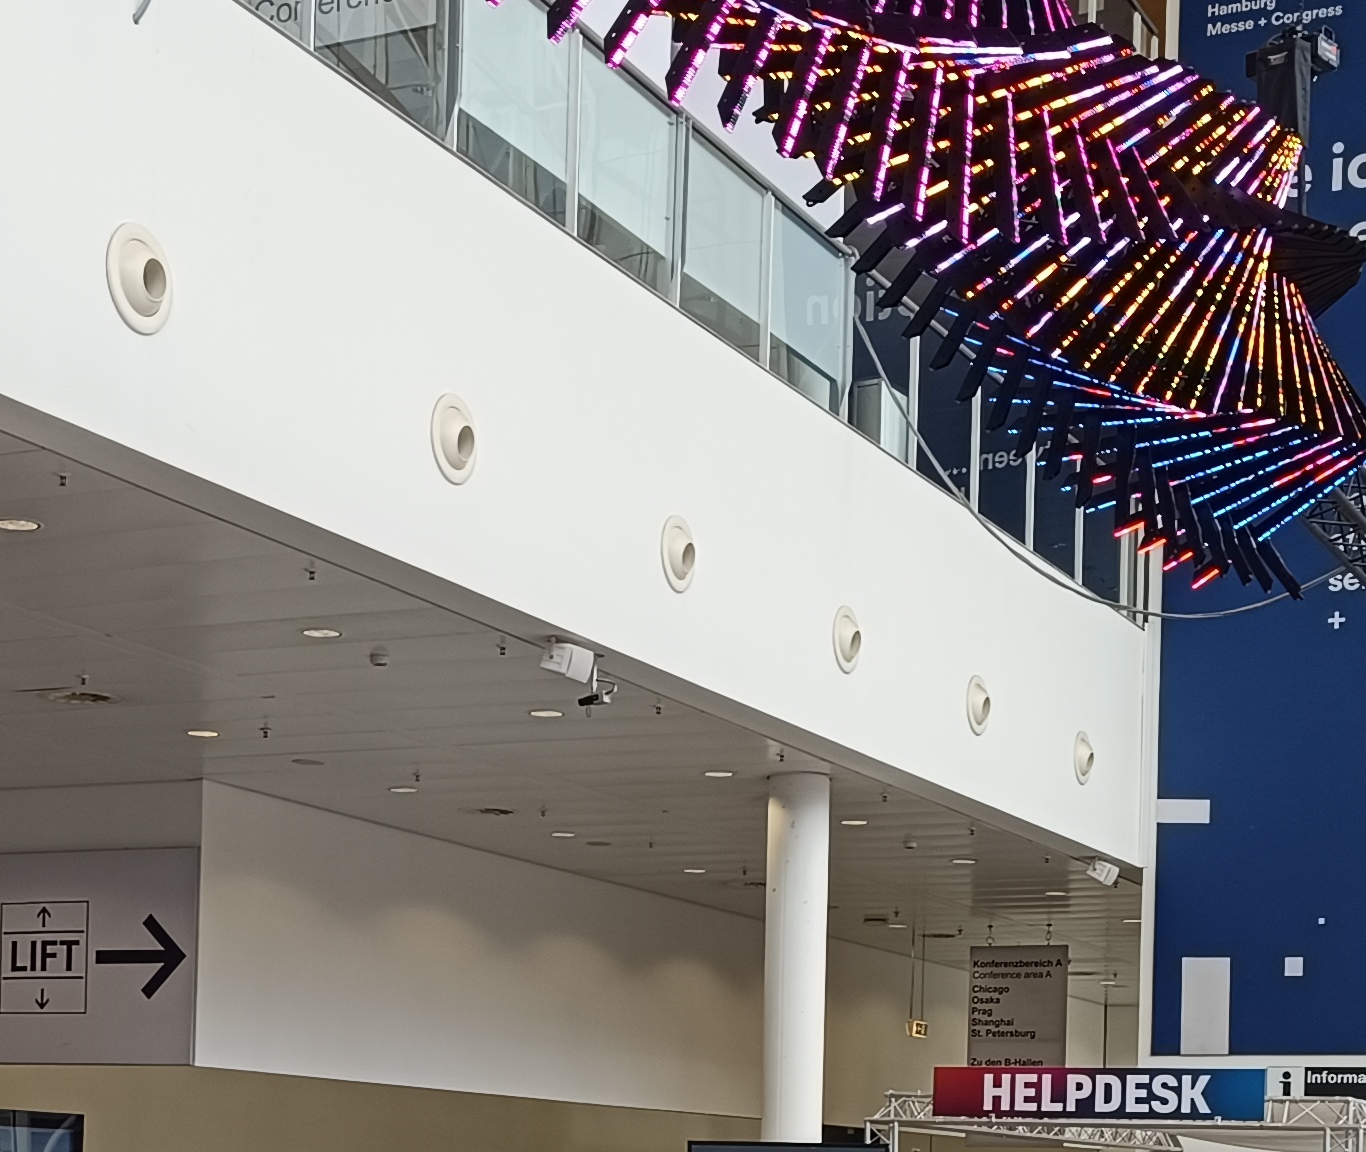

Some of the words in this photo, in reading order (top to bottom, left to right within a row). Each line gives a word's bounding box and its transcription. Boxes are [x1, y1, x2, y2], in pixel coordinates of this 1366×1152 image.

[1207, 0, 1276, 17] Hamburg
[1206, 20, 1254, 36] Messe
[9, 940, 81, 972] LIFT
[972, 958, 1054, 968] Konferenzbereich
[1055, 958, 1063, 967] A
[972, 970, 1022, 980] Conference
[1045, 970, 1053, 978] A
[972, 984, 1010, 995] Chicago
[971, 995, 1001, 1005] Osaka
[971, 1006, 993, 1017] Prag
[971, 1017, 1015, 1028] Shanghai
[985, 1028, 1036, 1039] Petersburg
[970, 1057, 983, 1067] Zu
[984, 1057, 1003, 1067] den
[982, 1073, 1212, 1115] HELPDESK
